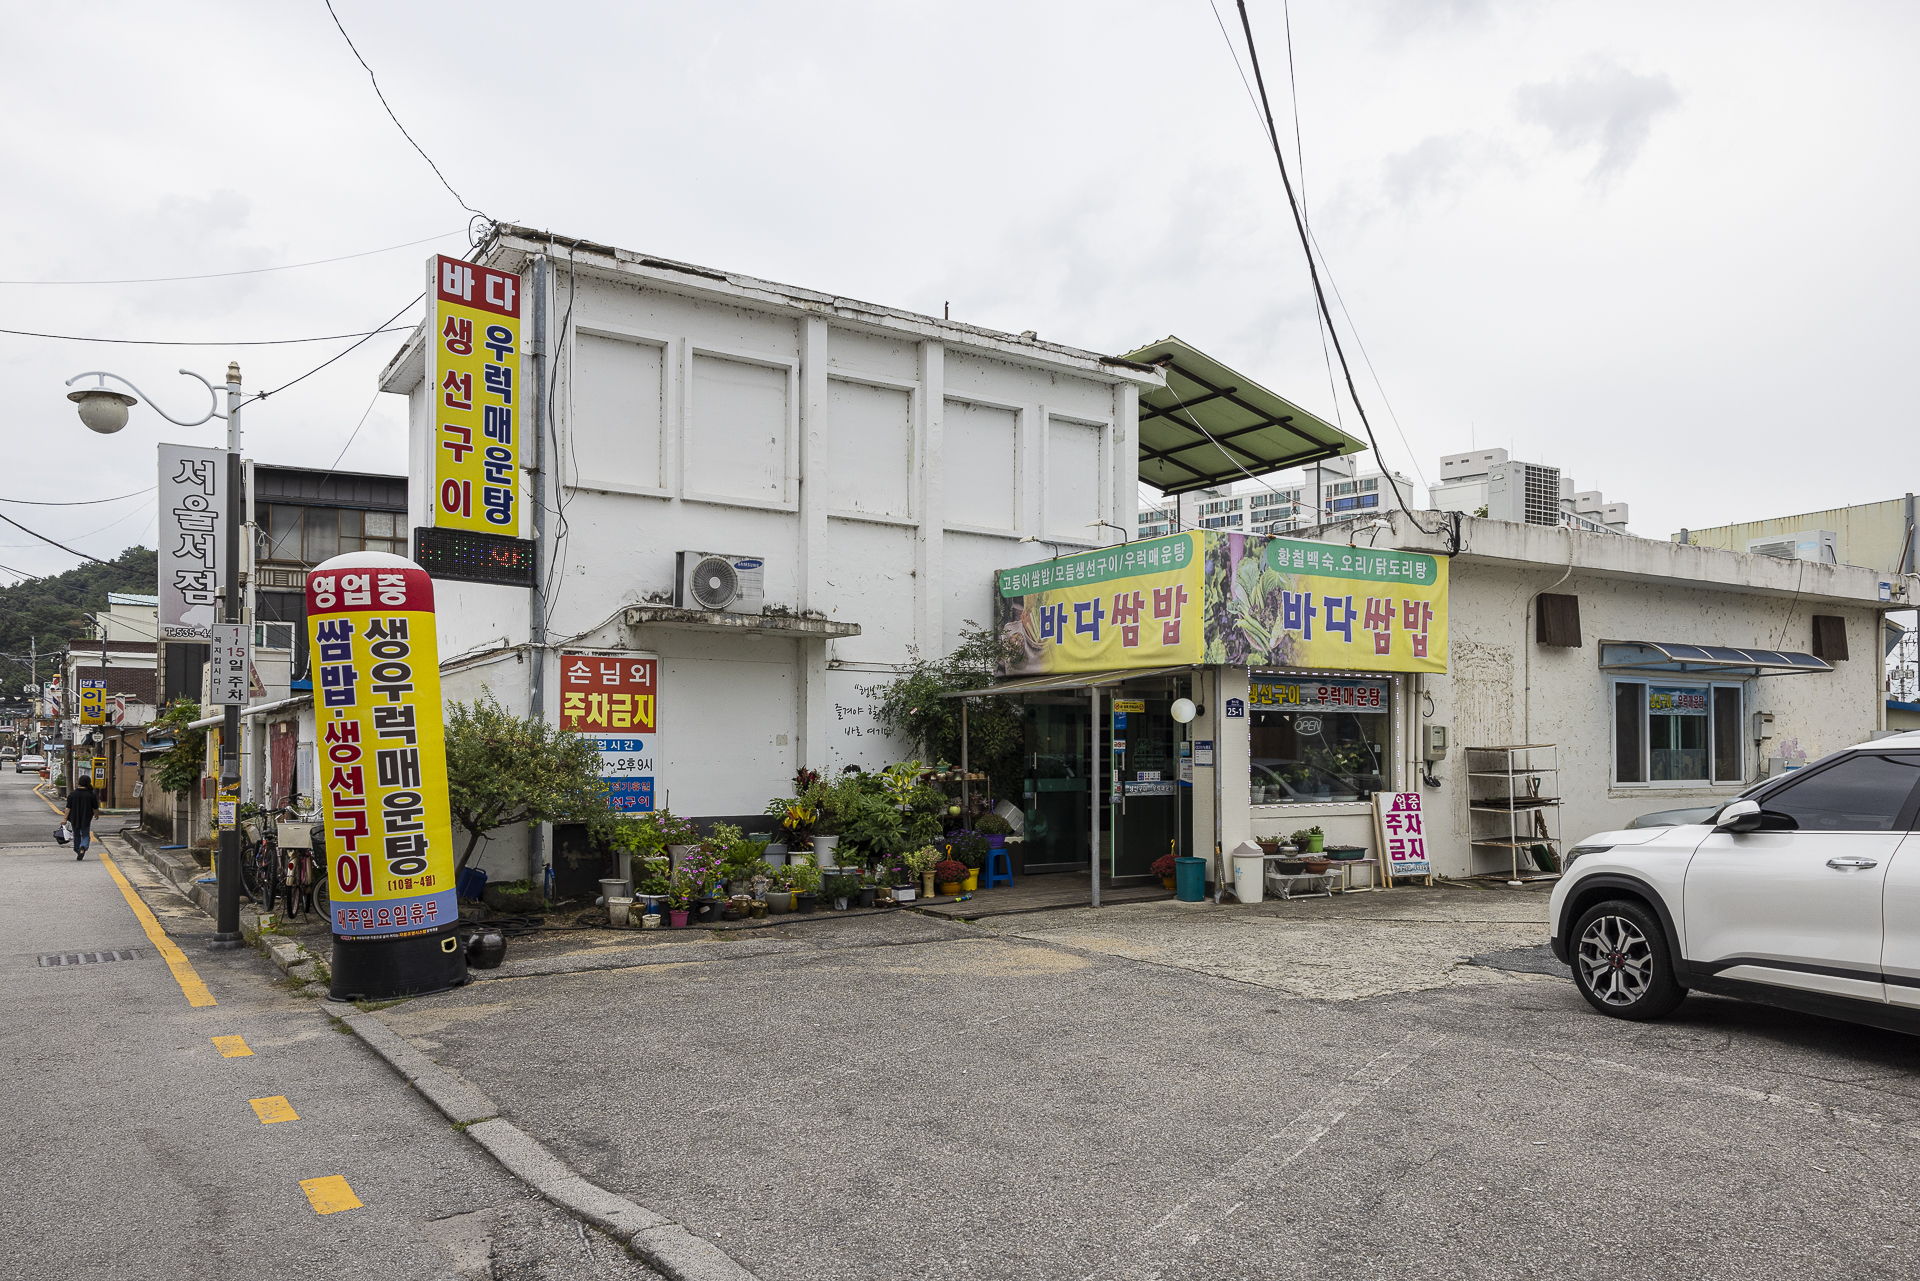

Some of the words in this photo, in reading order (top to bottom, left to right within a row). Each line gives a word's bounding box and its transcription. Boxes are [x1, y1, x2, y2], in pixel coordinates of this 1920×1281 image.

[442, 261, 516, 312] 바다
[441, 315, 475, 519] 생선구이
[482, 324, 516, 526] 우럭매운탕
[172, 459, 219, 606] 서울서점
[737, 560, 760, 568] SAMSUNG
[312, 573, 407, 609] 영업중
[82, 689, 105, 718] 이발
[1249, 683, 1300, 705] 생선구이
[1317, 686, 1381, 708] 우럭매운탕
[1650, 694, 1672, 709] 생선구이
[563, 691, 654, 728] 주차금지
[835, 703, 864, 721] 즐겨야
[1228, 707, 1242, 716] 25-1
[844, 726, 863, 737] 바로
[1294, 720, 1322, 731] OPEN
[364, 617, 429, 878] 생우럭매운탕
[611, 781, 650, 792] 정기휴일
[1385, 813, 1422, 836] 주차
[1389, 838, 1426, 861] 금지
[337, 901, 439, 930] 매주일요일휴무
